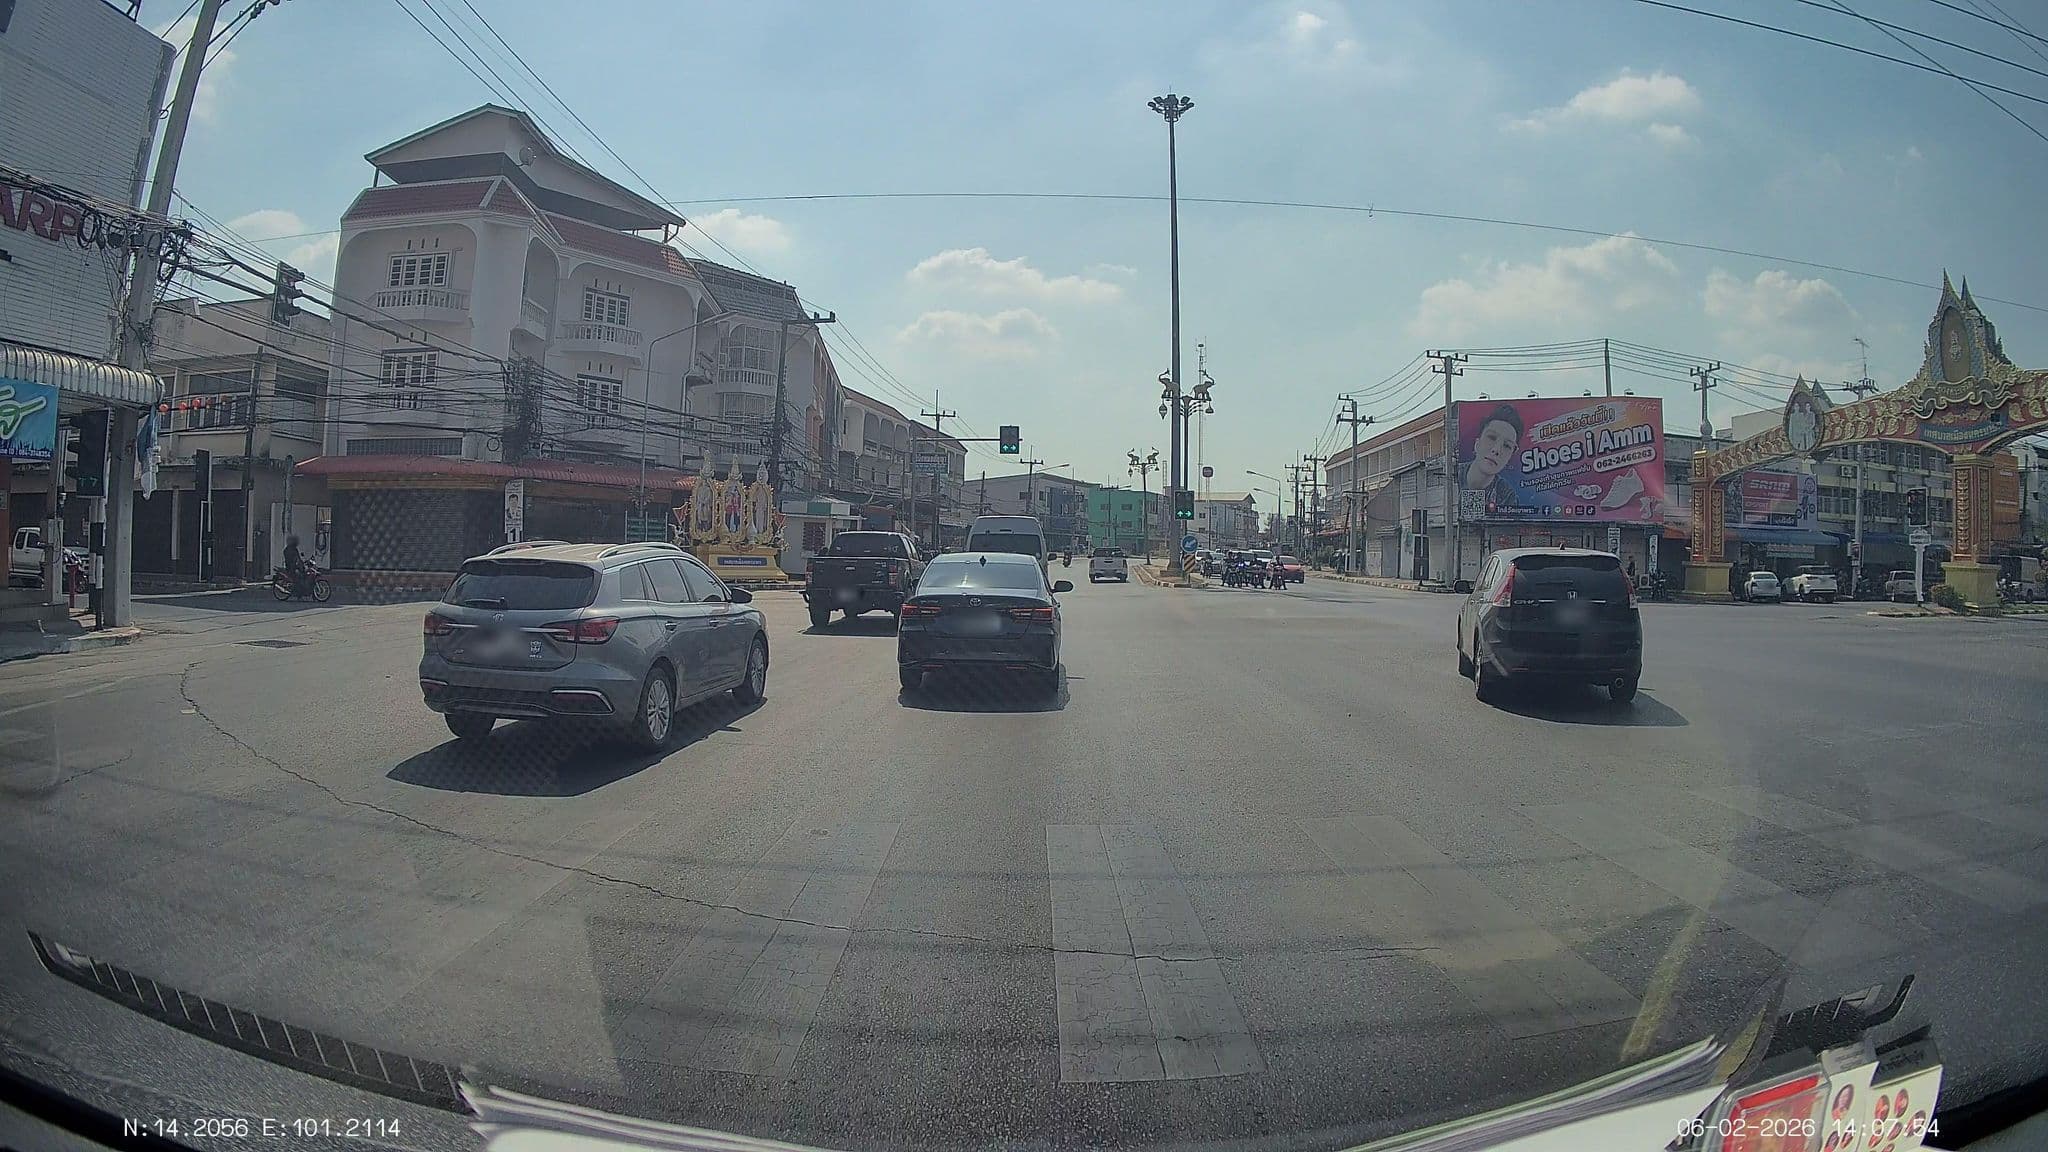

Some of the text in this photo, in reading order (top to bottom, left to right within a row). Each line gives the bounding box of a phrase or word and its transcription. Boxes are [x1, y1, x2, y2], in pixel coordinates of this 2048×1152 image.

[1520, 423, 1653, 473] Shoes i Amm
